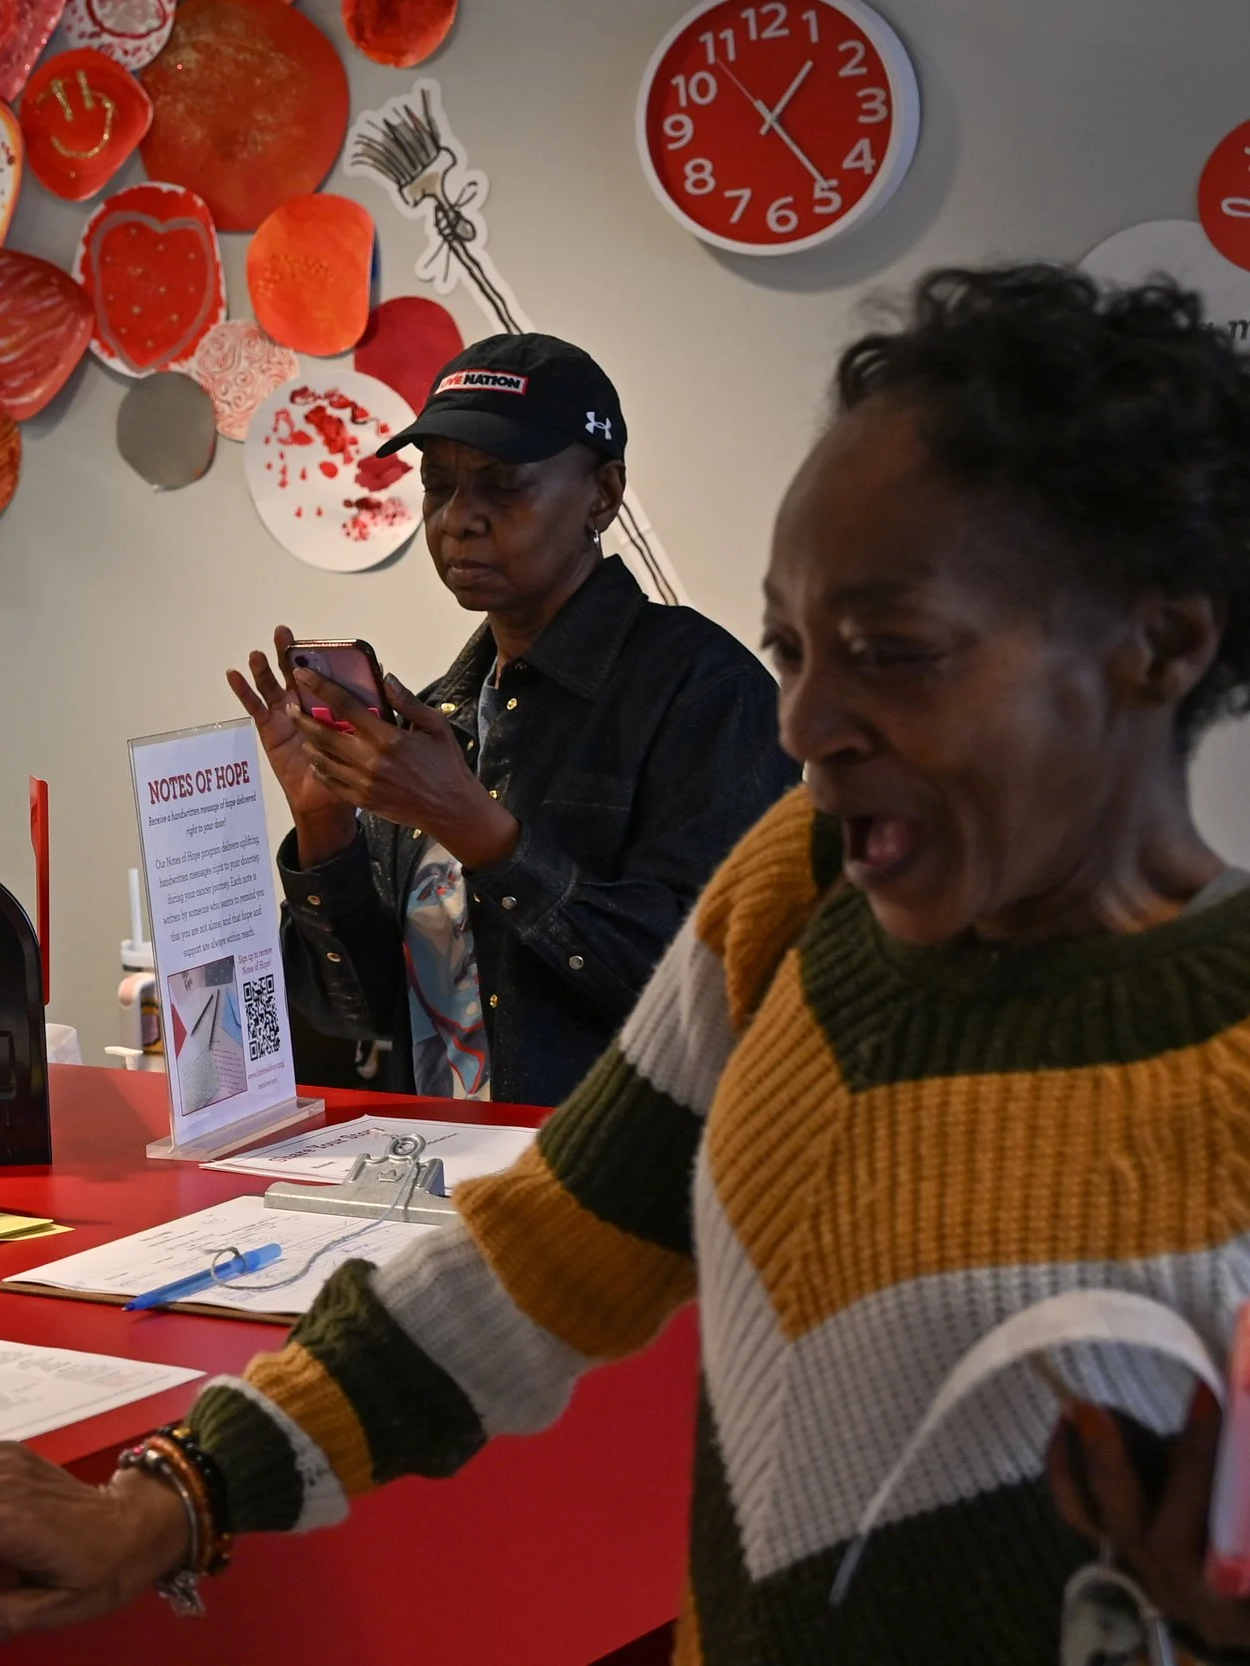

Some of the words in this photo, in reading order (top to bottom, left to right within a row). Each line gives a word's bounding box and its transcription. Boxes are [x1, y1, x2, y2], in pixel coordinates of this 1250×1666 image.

[740, 2, 790, 41] 12
[802, 10, 819, 42] 1
[698, 28, 736, 64] 11
[838, 40, 868, 77] 2
[670, 70, 718, 108] 10
[856, 87, 888, 124] 3
[662, 113, 694, 150] 9
[842, 138, 876, 175] 4
[683, 158, 716, 196] 8
[724, 188, 752, 224] 7
[766, 196, 799, 234] 6
[813, 179, 842, 214] 5
[464, 374, 521, 389] NATION
[148, 774, 192, 804] NOTES
[196, 769, 211, 793] OF
[215, 761, 249, 788] HOPE
